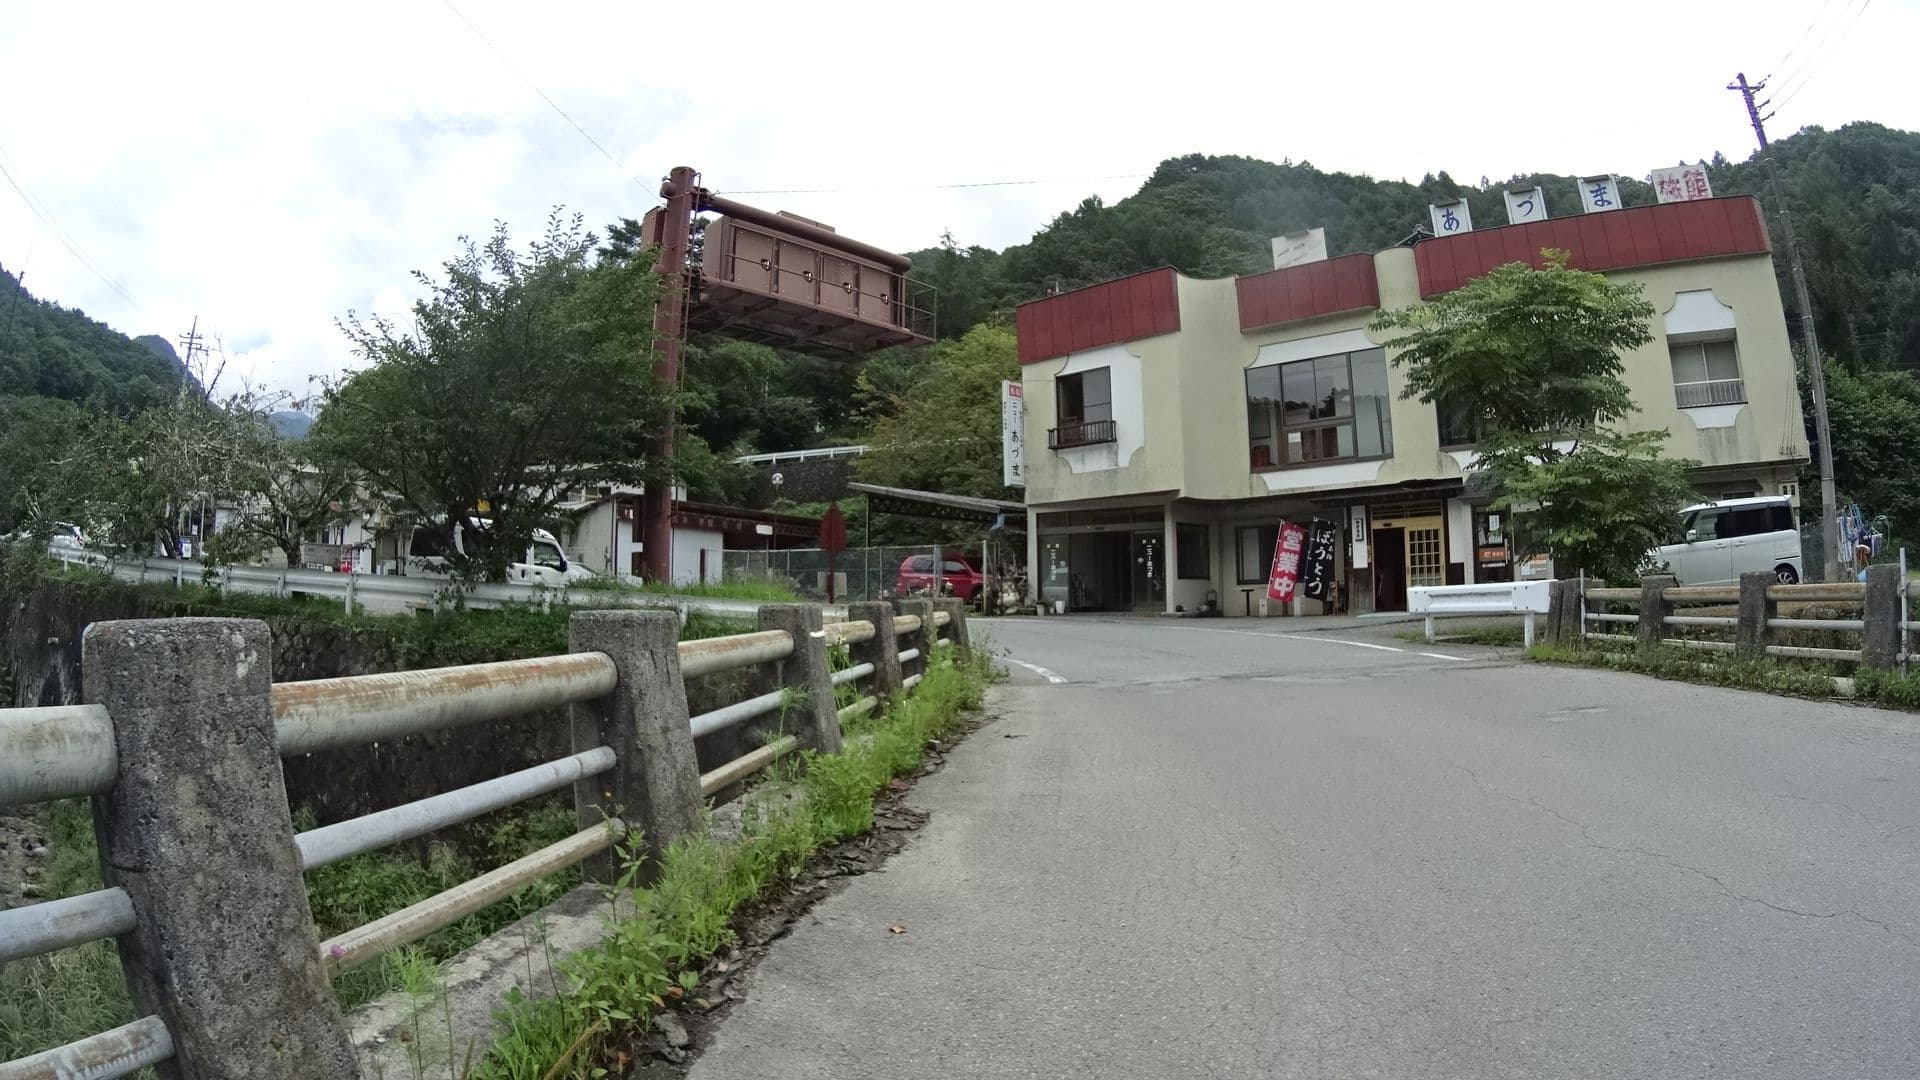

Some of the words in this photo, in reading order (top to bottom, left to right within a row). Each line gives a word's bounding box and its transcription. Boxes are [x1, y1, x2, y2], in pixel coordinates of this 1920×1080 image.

[1441, 182, 1613, 232] あづま
[1011, 401, 1021, 478] ニューあづま
[1273, 528, 1304, 598] 営業中
